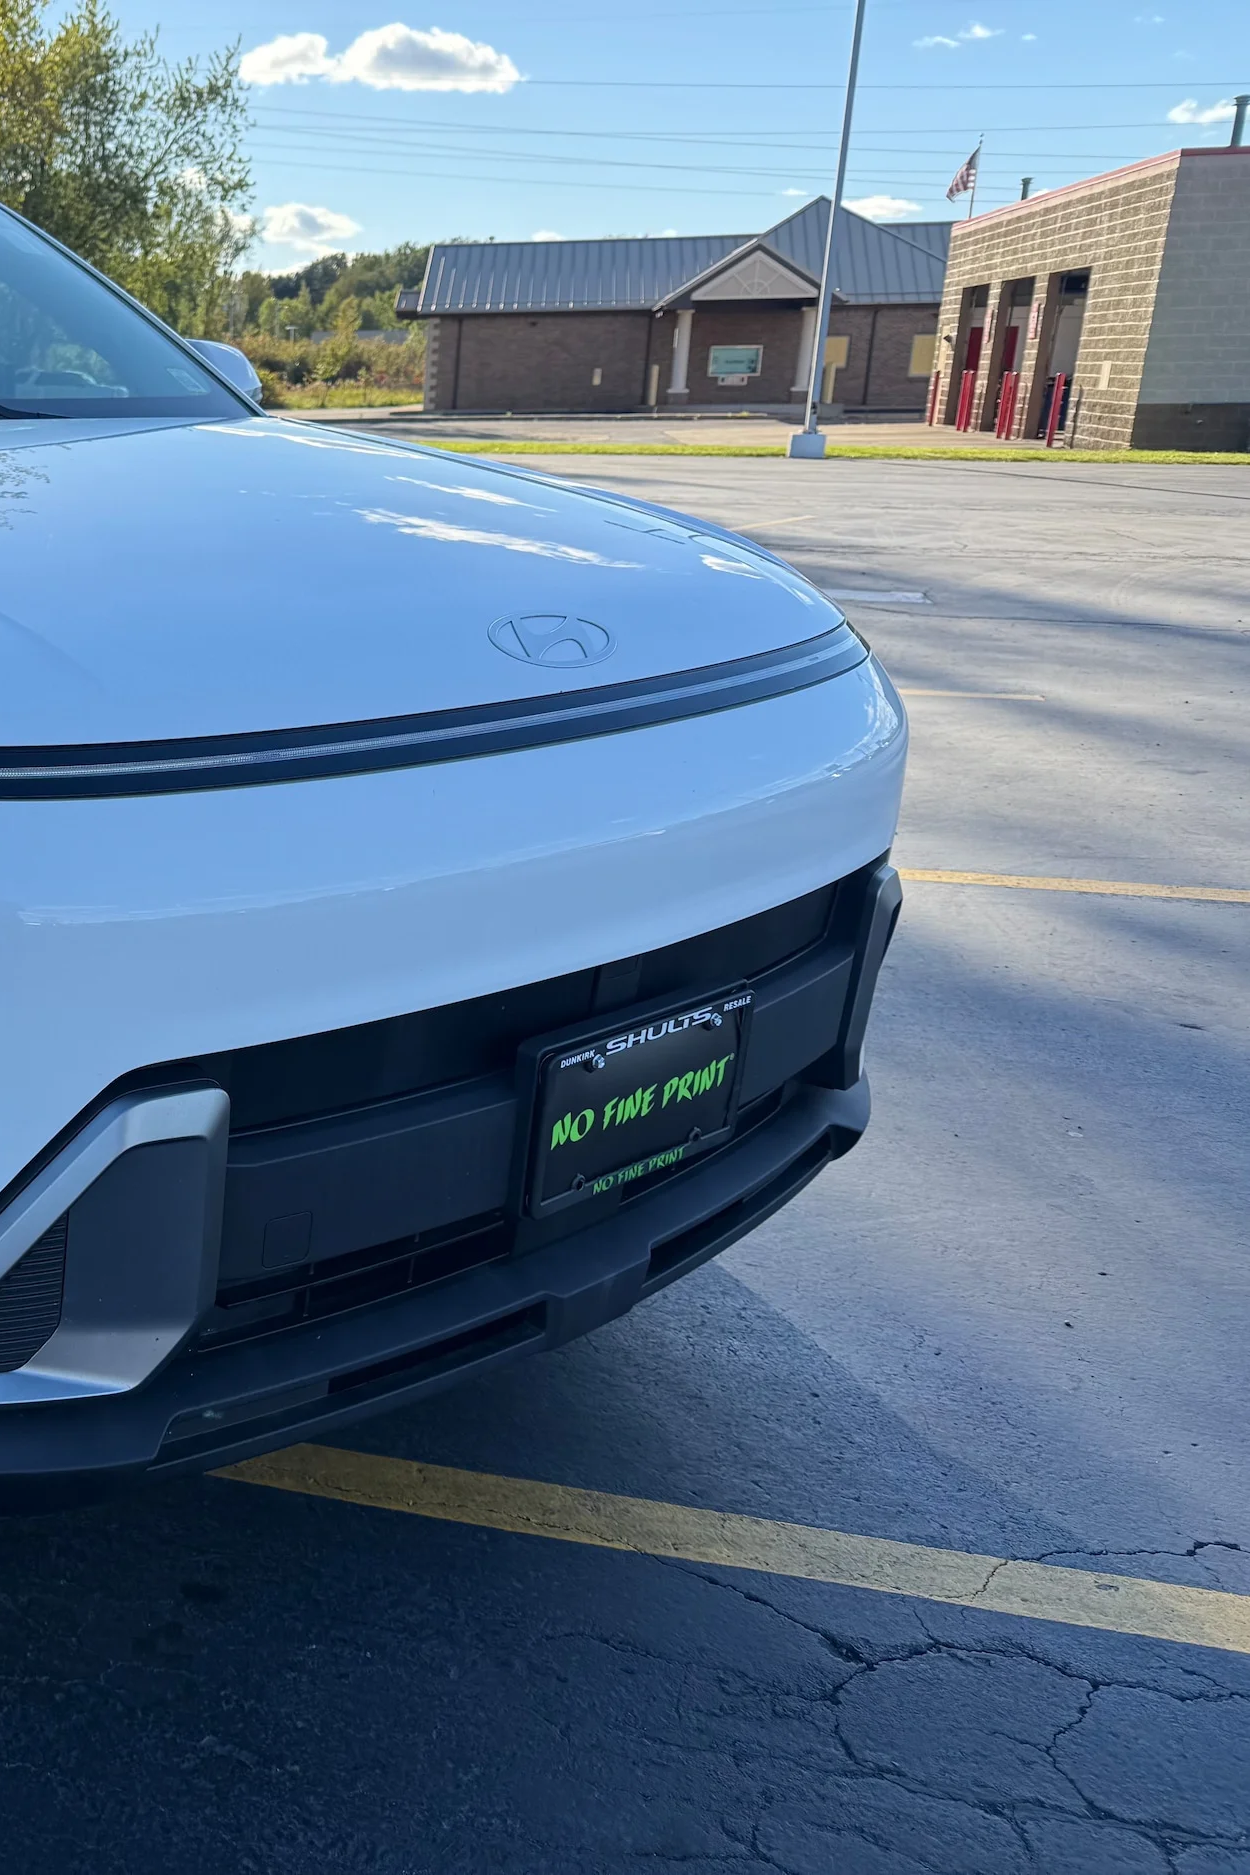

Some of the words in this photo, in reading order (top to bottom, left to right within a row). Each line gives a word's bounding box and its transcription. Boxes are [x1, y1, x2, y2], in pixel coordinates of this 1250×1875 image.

[723, 995, 751, 1012] RESALE
[605, 1006, 713, 1056] SHULTS
[560, 1049, 595, 1069] DUNKIRK
[551, 1108, 595, 1151] NO
[603, 1083, 658, 1131] FINE
[592, 1176, 614, 1196] NO
[617, 1163, 645, 1185] FINE
[649, 1147, 685, 1171] PRINT
